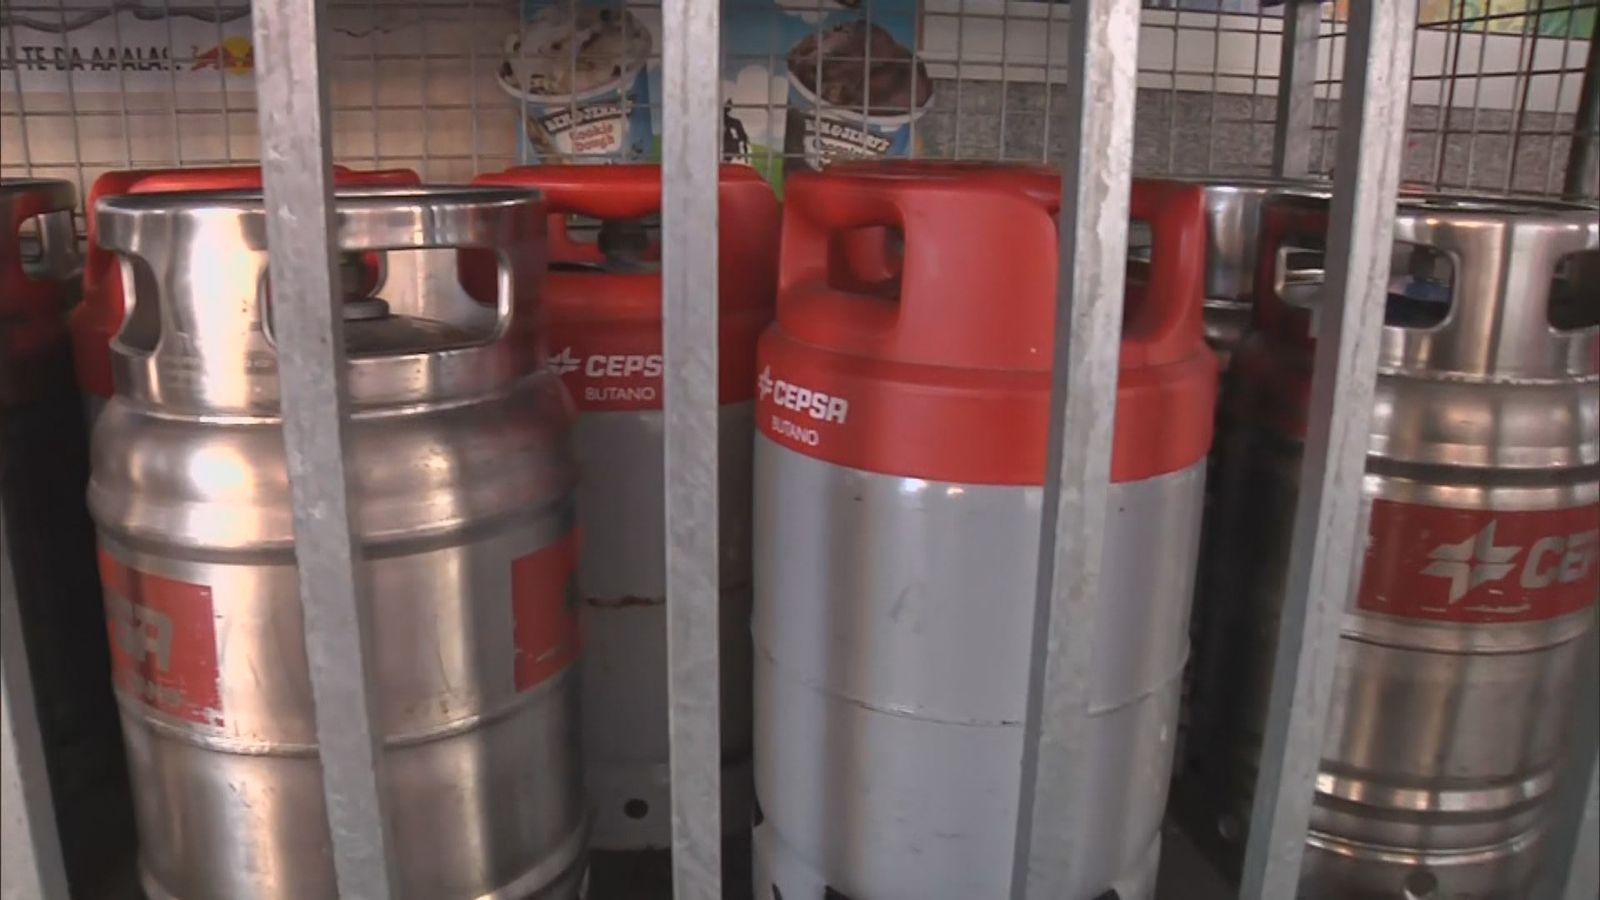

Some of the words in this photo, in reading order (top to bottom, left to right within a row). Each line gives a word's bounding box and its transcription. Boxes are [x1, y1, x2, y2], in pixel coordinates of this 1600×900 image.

[22, 46, 47, 70] TE
[54, 46, 85, 70] DA
[585, 386, 656, 401] BUTANO
[773, 379, 849, 425] CEPSA
[771, 414, 820, 446] BUTANO
